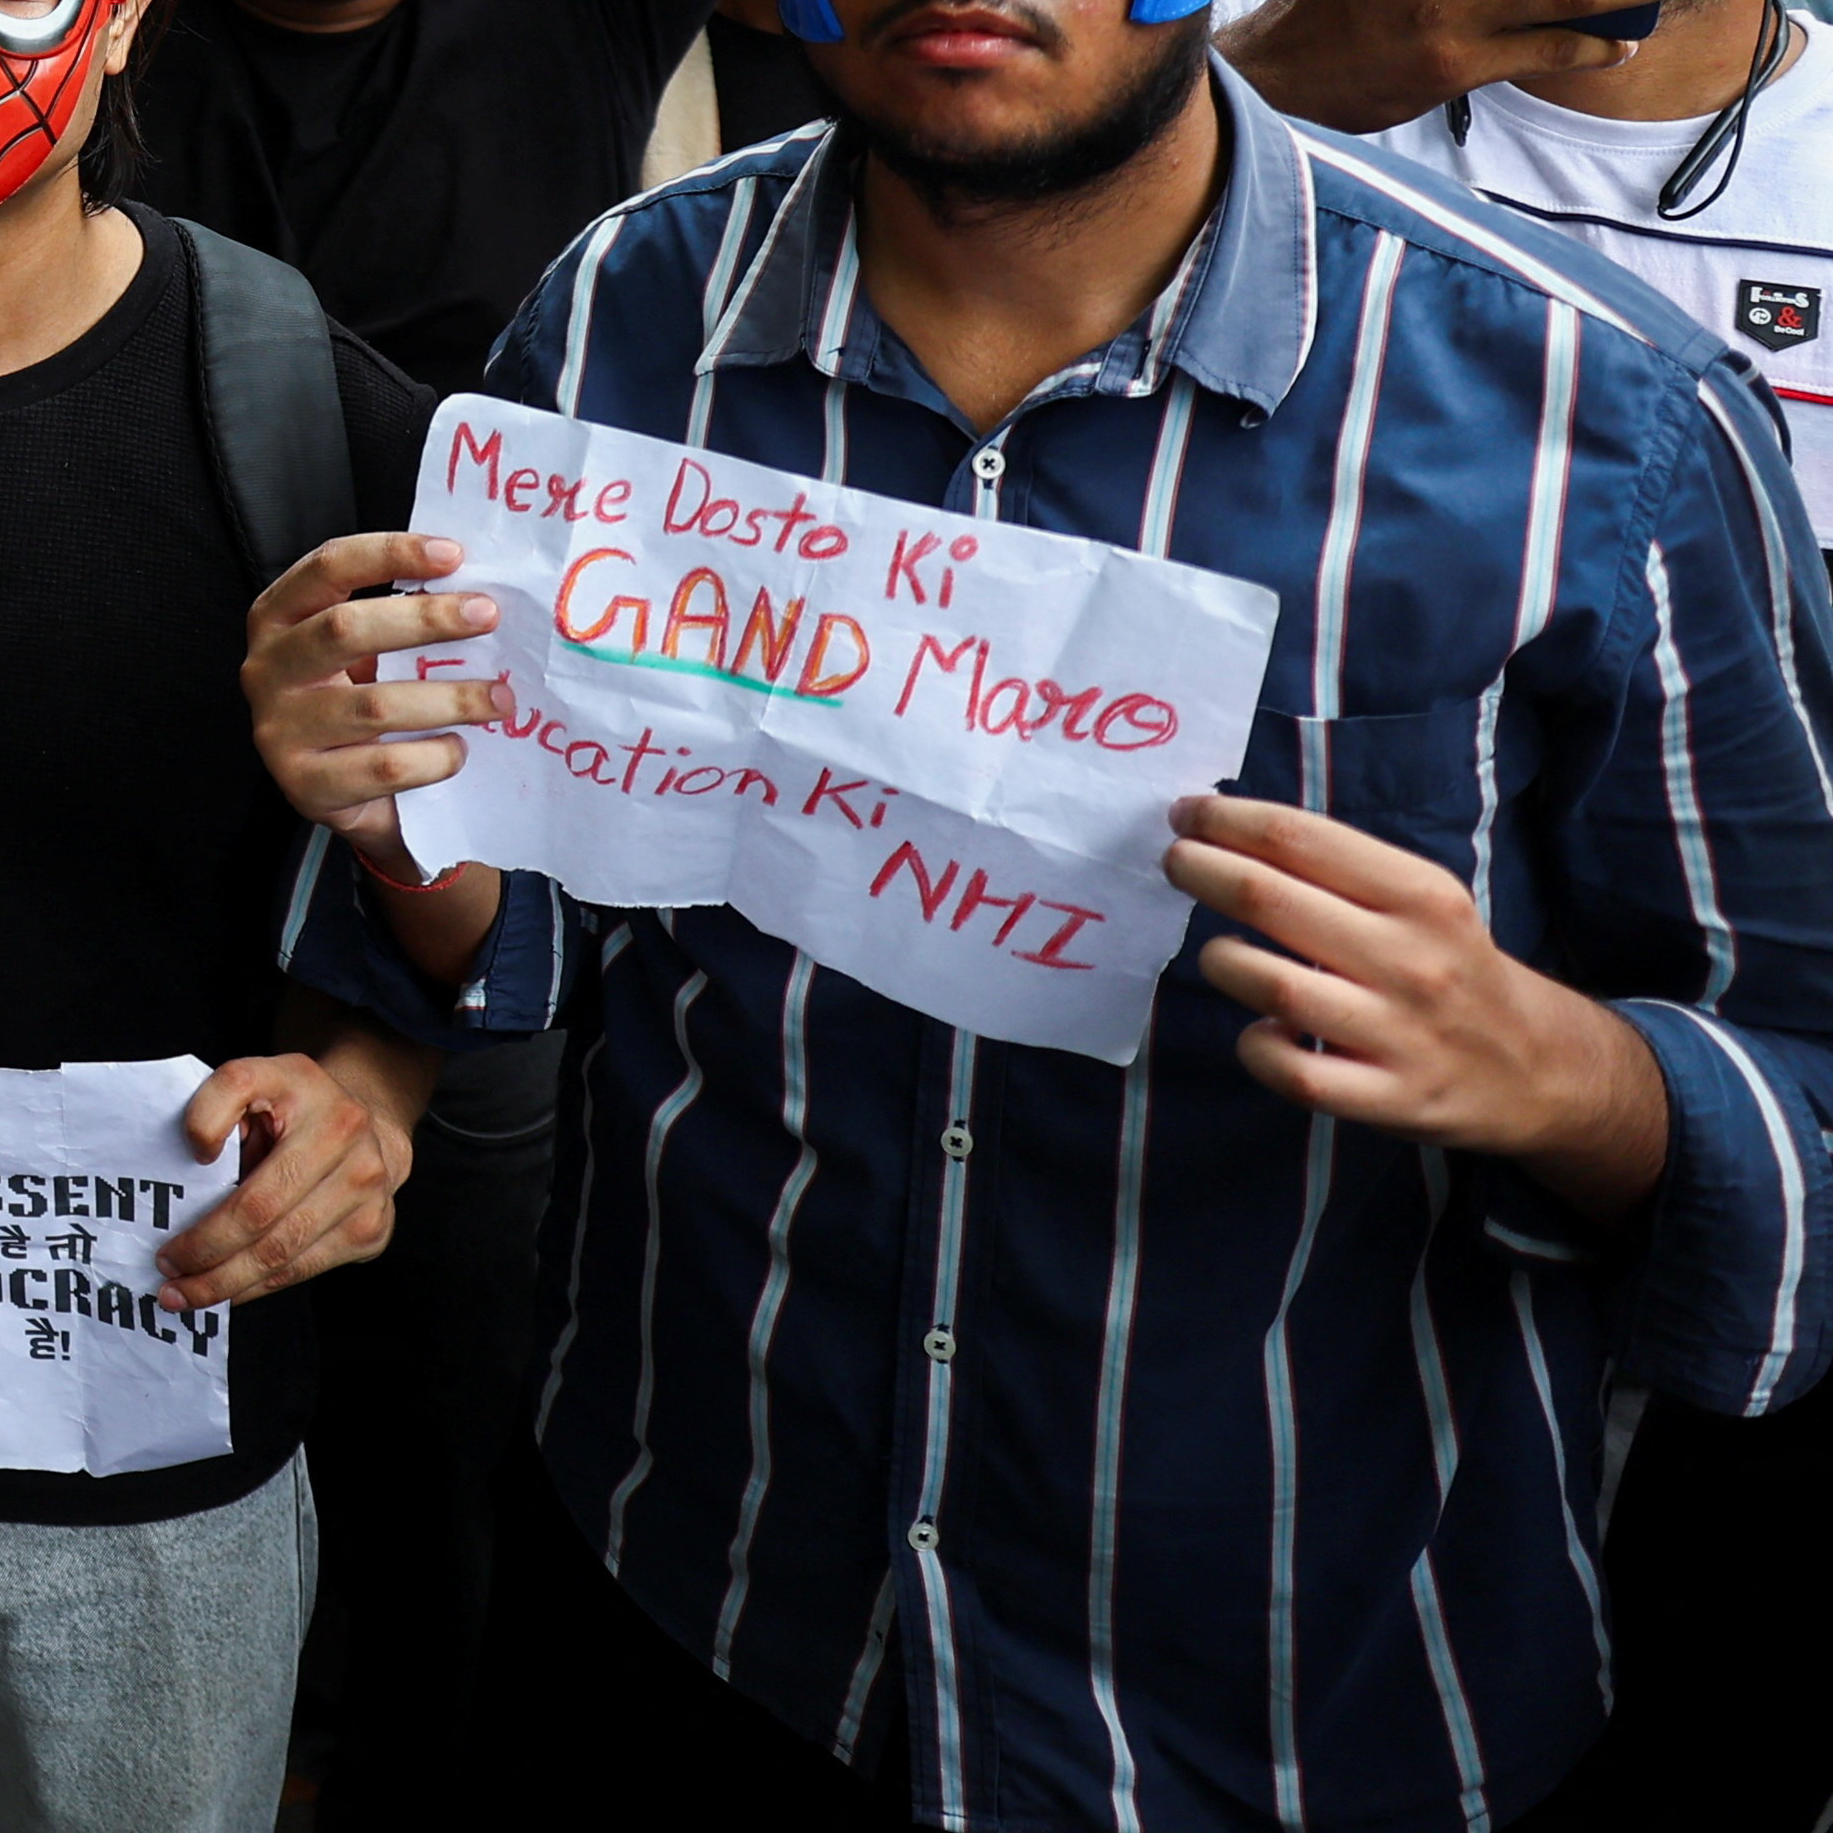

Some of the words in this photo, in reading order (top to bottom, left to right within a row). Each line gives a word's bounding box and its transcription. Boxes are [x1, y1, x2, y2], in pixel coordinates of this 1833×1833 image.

[448, 421, 632, 524] Mere
[663, 457, 849, 562] Dosto
[883, 530, 979, 611] Ki
[553, 545, 873, 699] GAND
[893, 633, 1180, 753] Maro
[416, 654, 780, 807] ucation
[802, 768, 899, 832] Ki
[868, 839, 1107, 972] NHI
[44, 1222, 98, 1265] तो
[24, 1317, 72, 1362] है!
